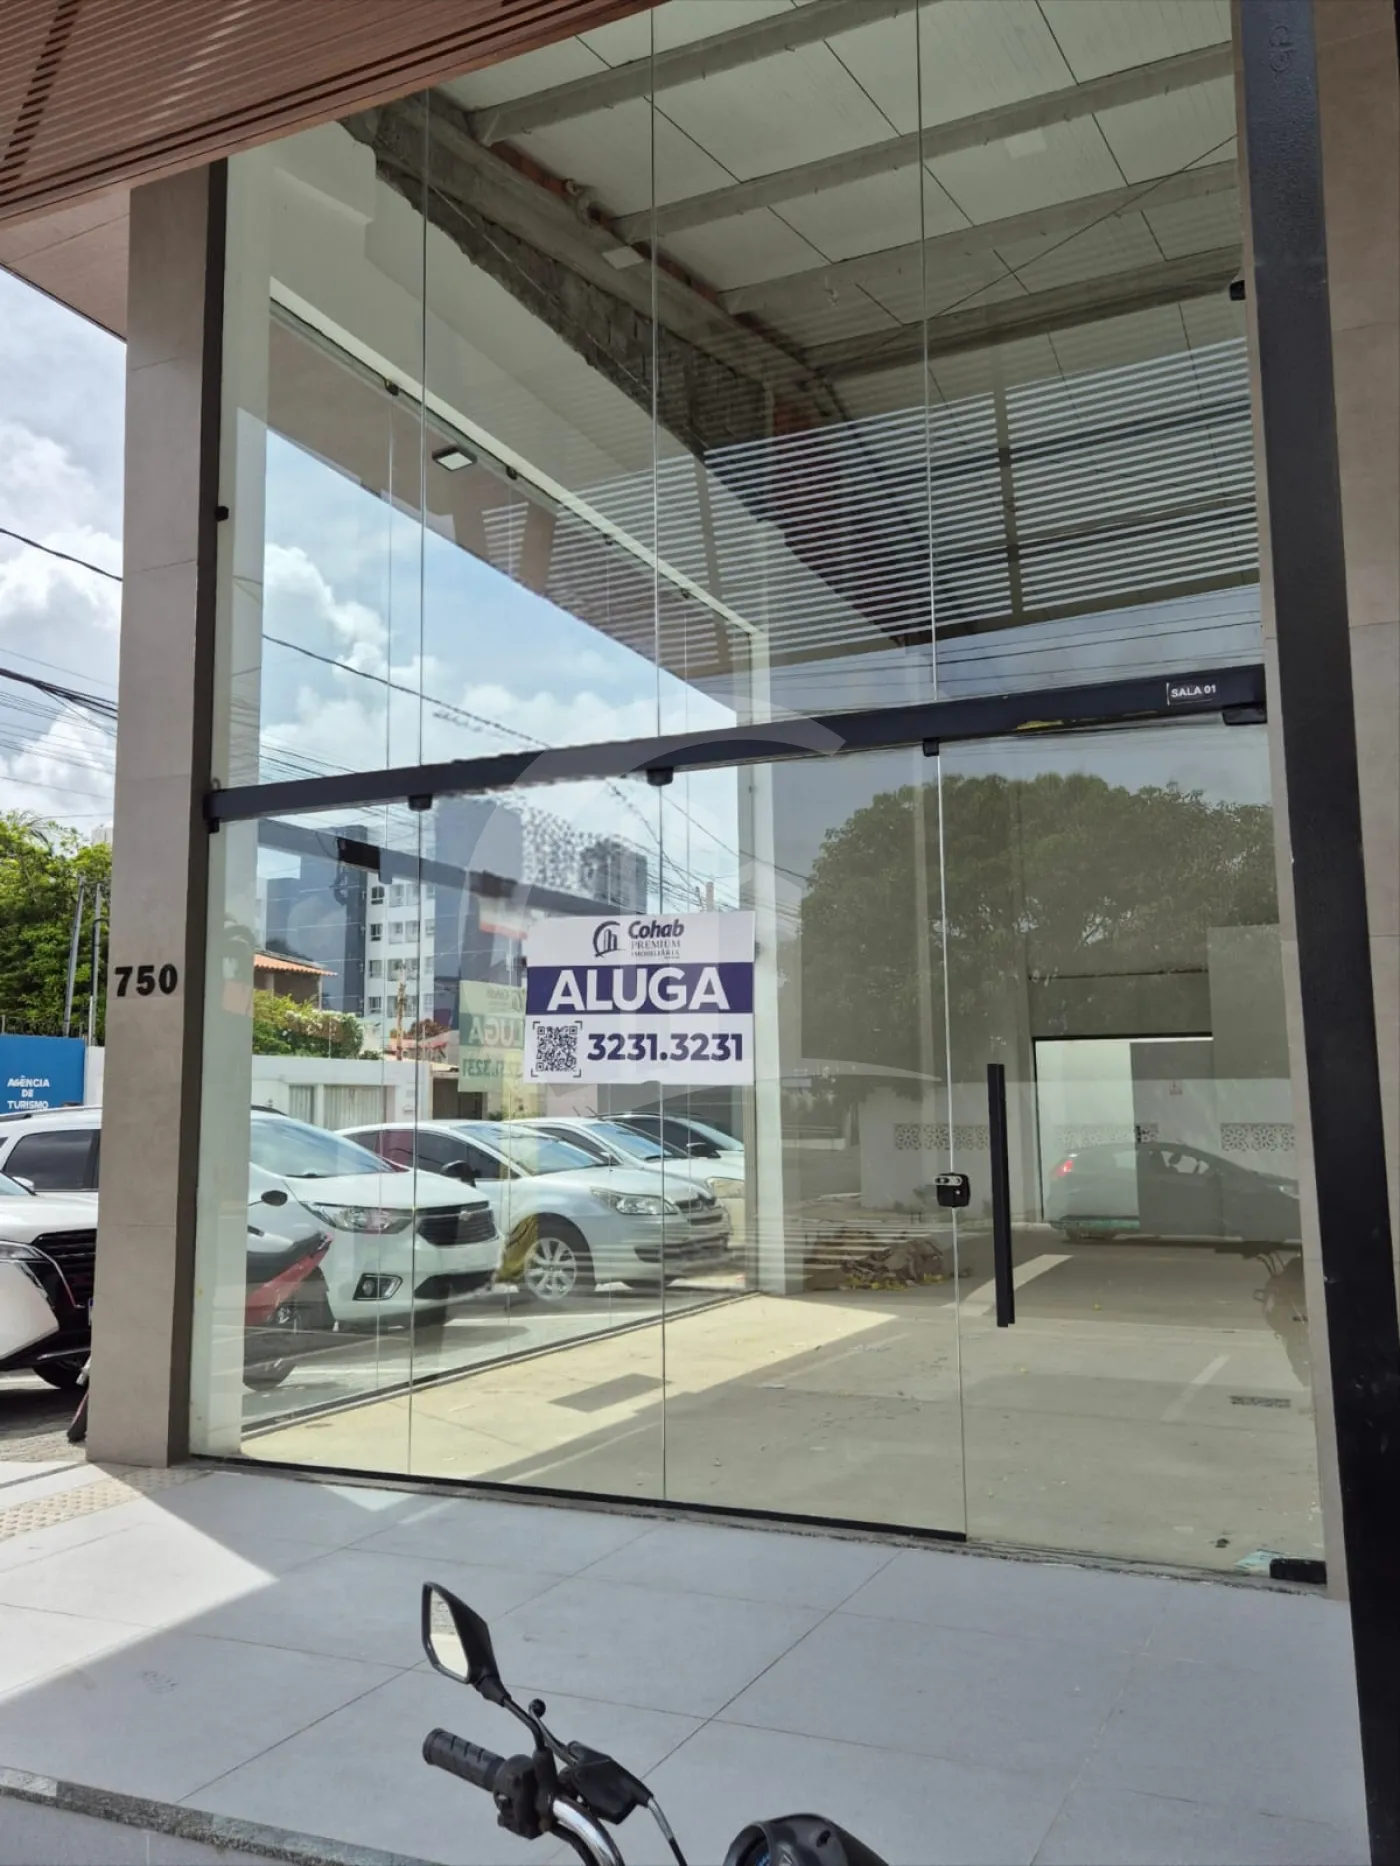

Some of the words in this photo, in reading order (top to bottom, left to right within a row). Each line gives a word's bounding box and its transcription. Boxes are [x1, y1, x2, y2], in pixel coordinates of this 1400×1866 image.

[1171, 686, 1202, 698] SALA
[1203, 684, 1217, 694] 01
[628, 919, 684, 939] Cohab
[631, 939, 681, 949] PREMIUM
[115, 963, 178, 997] 750
[547, 967, 731, 1011] ALUGA
[587, 1033, 743, 1061] 3231.3231
[7, 1075, 50, 1088] AGÊNCIA
[21, 1089, 34, 1098] DE
[7, 1100, 49, 1110] TURISMO
